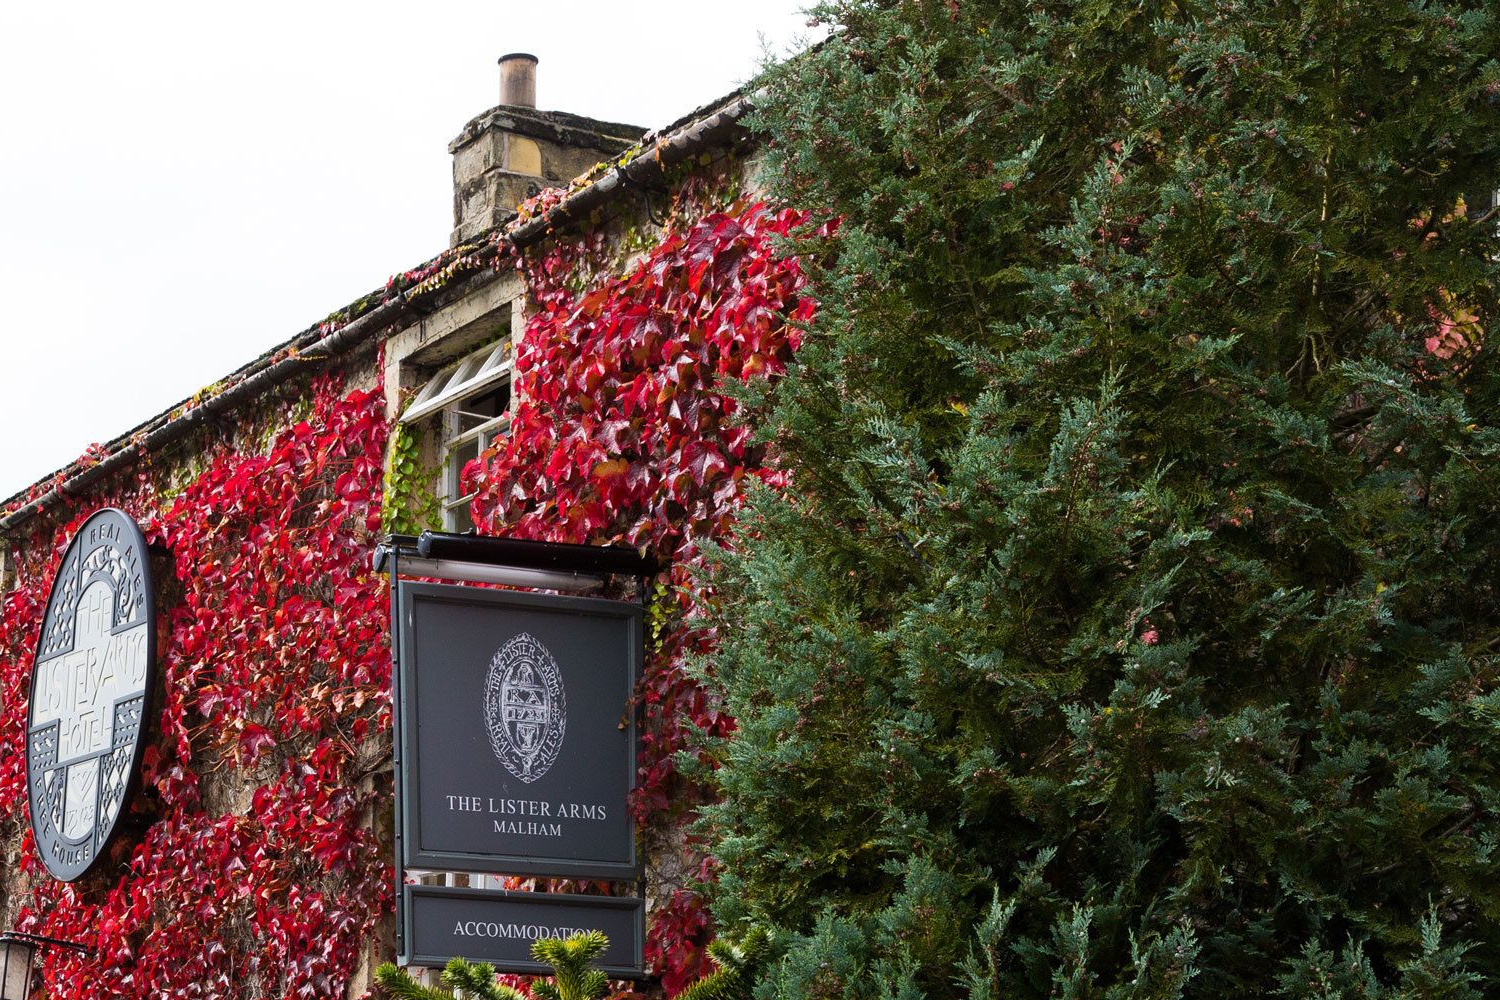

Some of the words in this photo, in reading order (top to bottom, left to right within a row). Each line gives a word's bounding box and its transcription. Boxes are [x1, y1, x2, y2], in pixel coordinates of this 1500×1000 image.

[90, 523, 120, 545] REAL
[125, 544, 144, 608] ALES
[76, 590, 112, 647] THE
[38, 647, 98, 714] LISTER
[92, 632, 146, 705] ARMS
[490, 667, 503, 693] THE
[503, 642, 536, 664] LISTER
[542, 664, 561, 697] ARMS
[61, 706, 112, 755] HOTEL
[491, 721, 511, 761] REAL
[540, 729, 559, 765] ALES
[35, 776, 51, 839] FREE
[51, 839, 90, 866] HOUSE
[446, 795, 482, 812] THE
[489, 798, 551, 817] LISTER
[556, 803, 607, 820] ARMS
[494, 820, 562, 837] MALHAM
